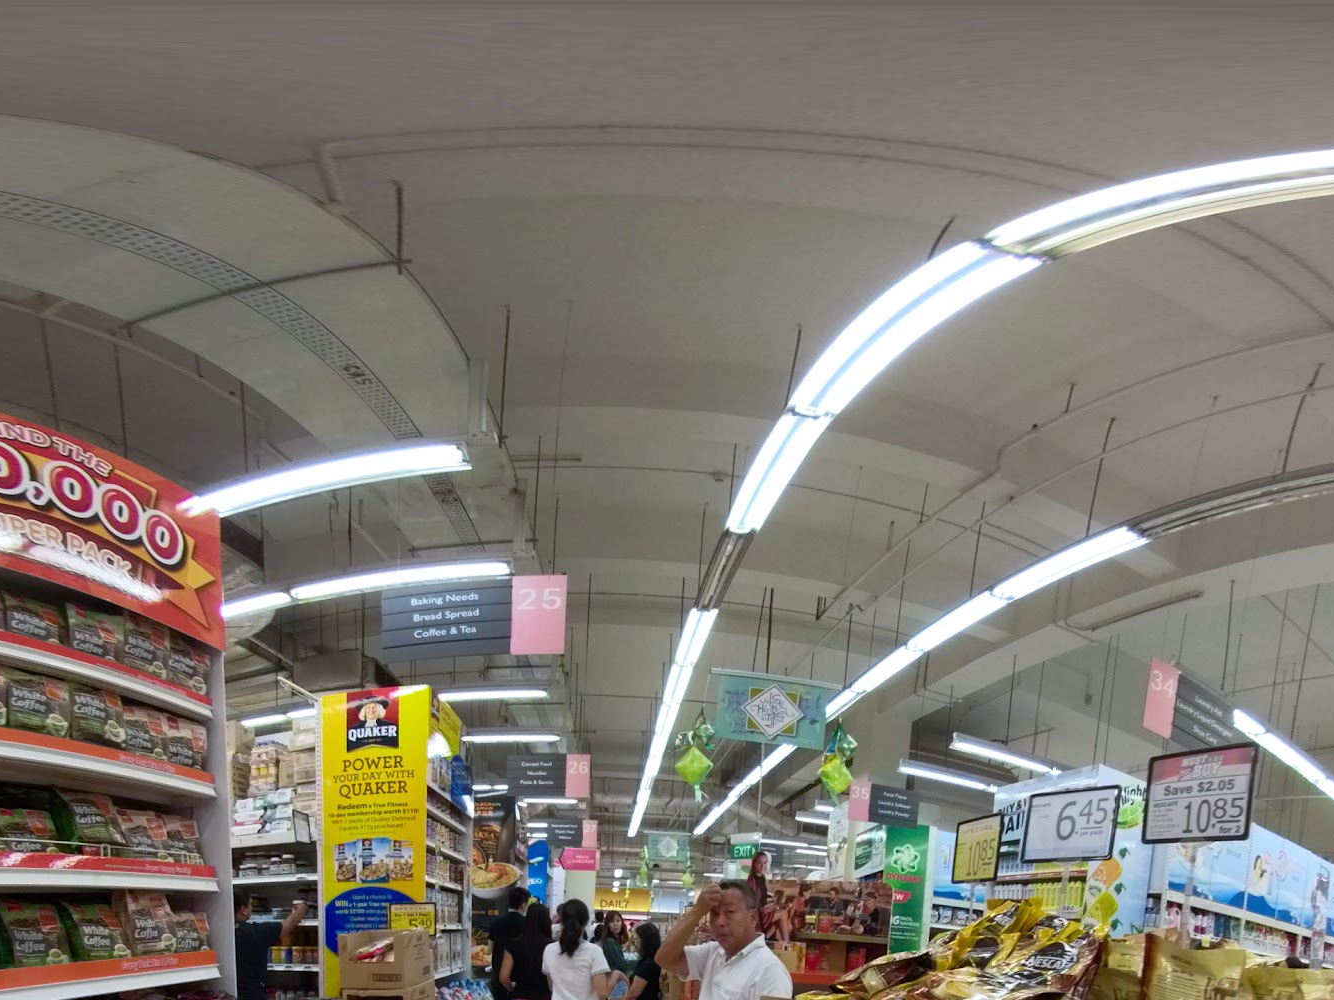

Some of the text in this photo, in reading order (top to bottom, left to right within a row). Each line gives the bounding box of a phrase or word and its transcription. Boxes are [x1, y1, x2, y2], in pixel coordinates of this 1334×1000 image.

[52, 436, 114, 478] THE
[67, 532, 132, 577] PACK
[410, 593, 479, 606] Baking Needs
[517, 588, 563, 610] 25
[13, 611, 47, 627] White
[413, 608, 479, 622] Bread Spread
[414, 626, 476, 639] Coffee & Tea
[1151, 670, 1176, 698] 34
[11, 687, 47, 702] White
[11, 698, 47, 713] Coffee
[74, 695, 106, 710] White
[1177, 699, 1197, 718] Laundry
[74, 704, 107, 719] Coffee
[348, 724, 398, 742] QUAKER
[343, 755, 404, 772] POWER
[568, 760, 588, 773] 26
[1192, 761, 1220, 778] BUY
[333, 770, 415, 785] YOUR DAY WITH
[338, 781, 408, 799] QUAKER
[851, 786, 869, 799] 35
[1164, 779, 1235, 797] Save $2.05
[337, 803, 367, 811] Redeem
[347, 809, 383, 817] membership
[1056, 797, 1109, 841] 6.45
[1182, 797, 1245, 834] 10.85
[1219, 825, 1232, 834] for
[734, 845, 752, 858] EXIT
[886, 873, 922, 883] DYNAMO
